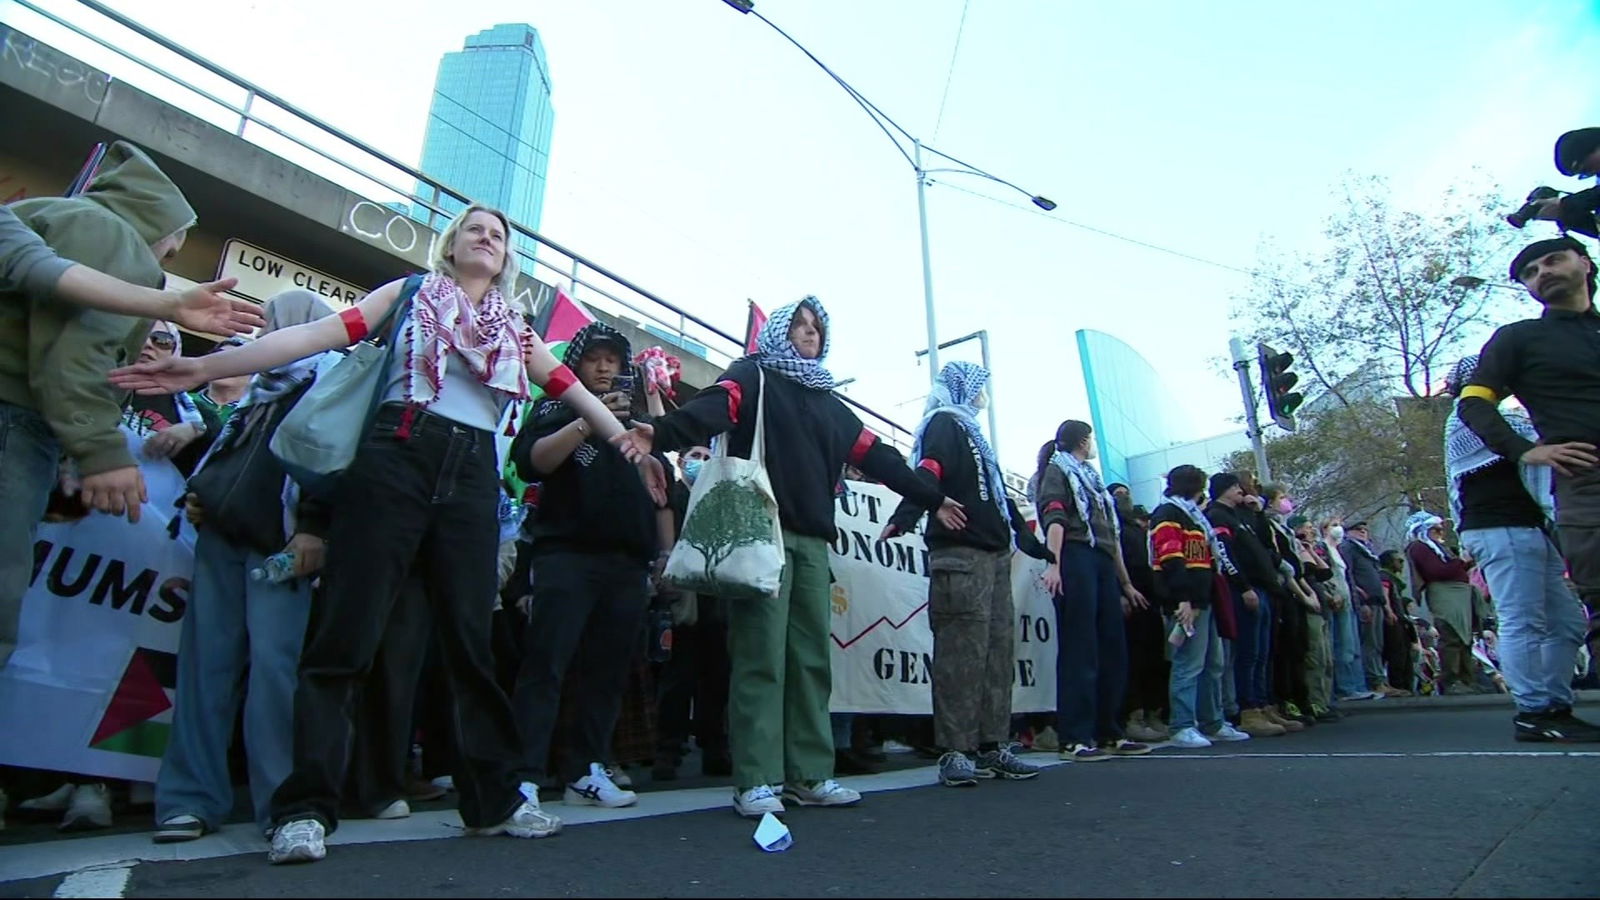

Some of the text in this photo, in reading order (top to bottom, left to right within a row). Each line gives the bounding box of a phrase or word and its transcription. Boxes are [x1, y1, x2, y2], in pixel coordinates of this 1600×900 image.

[238, 249, 366, 307] LOW CLEAR
[1020, 613, 1051, 644] TO
